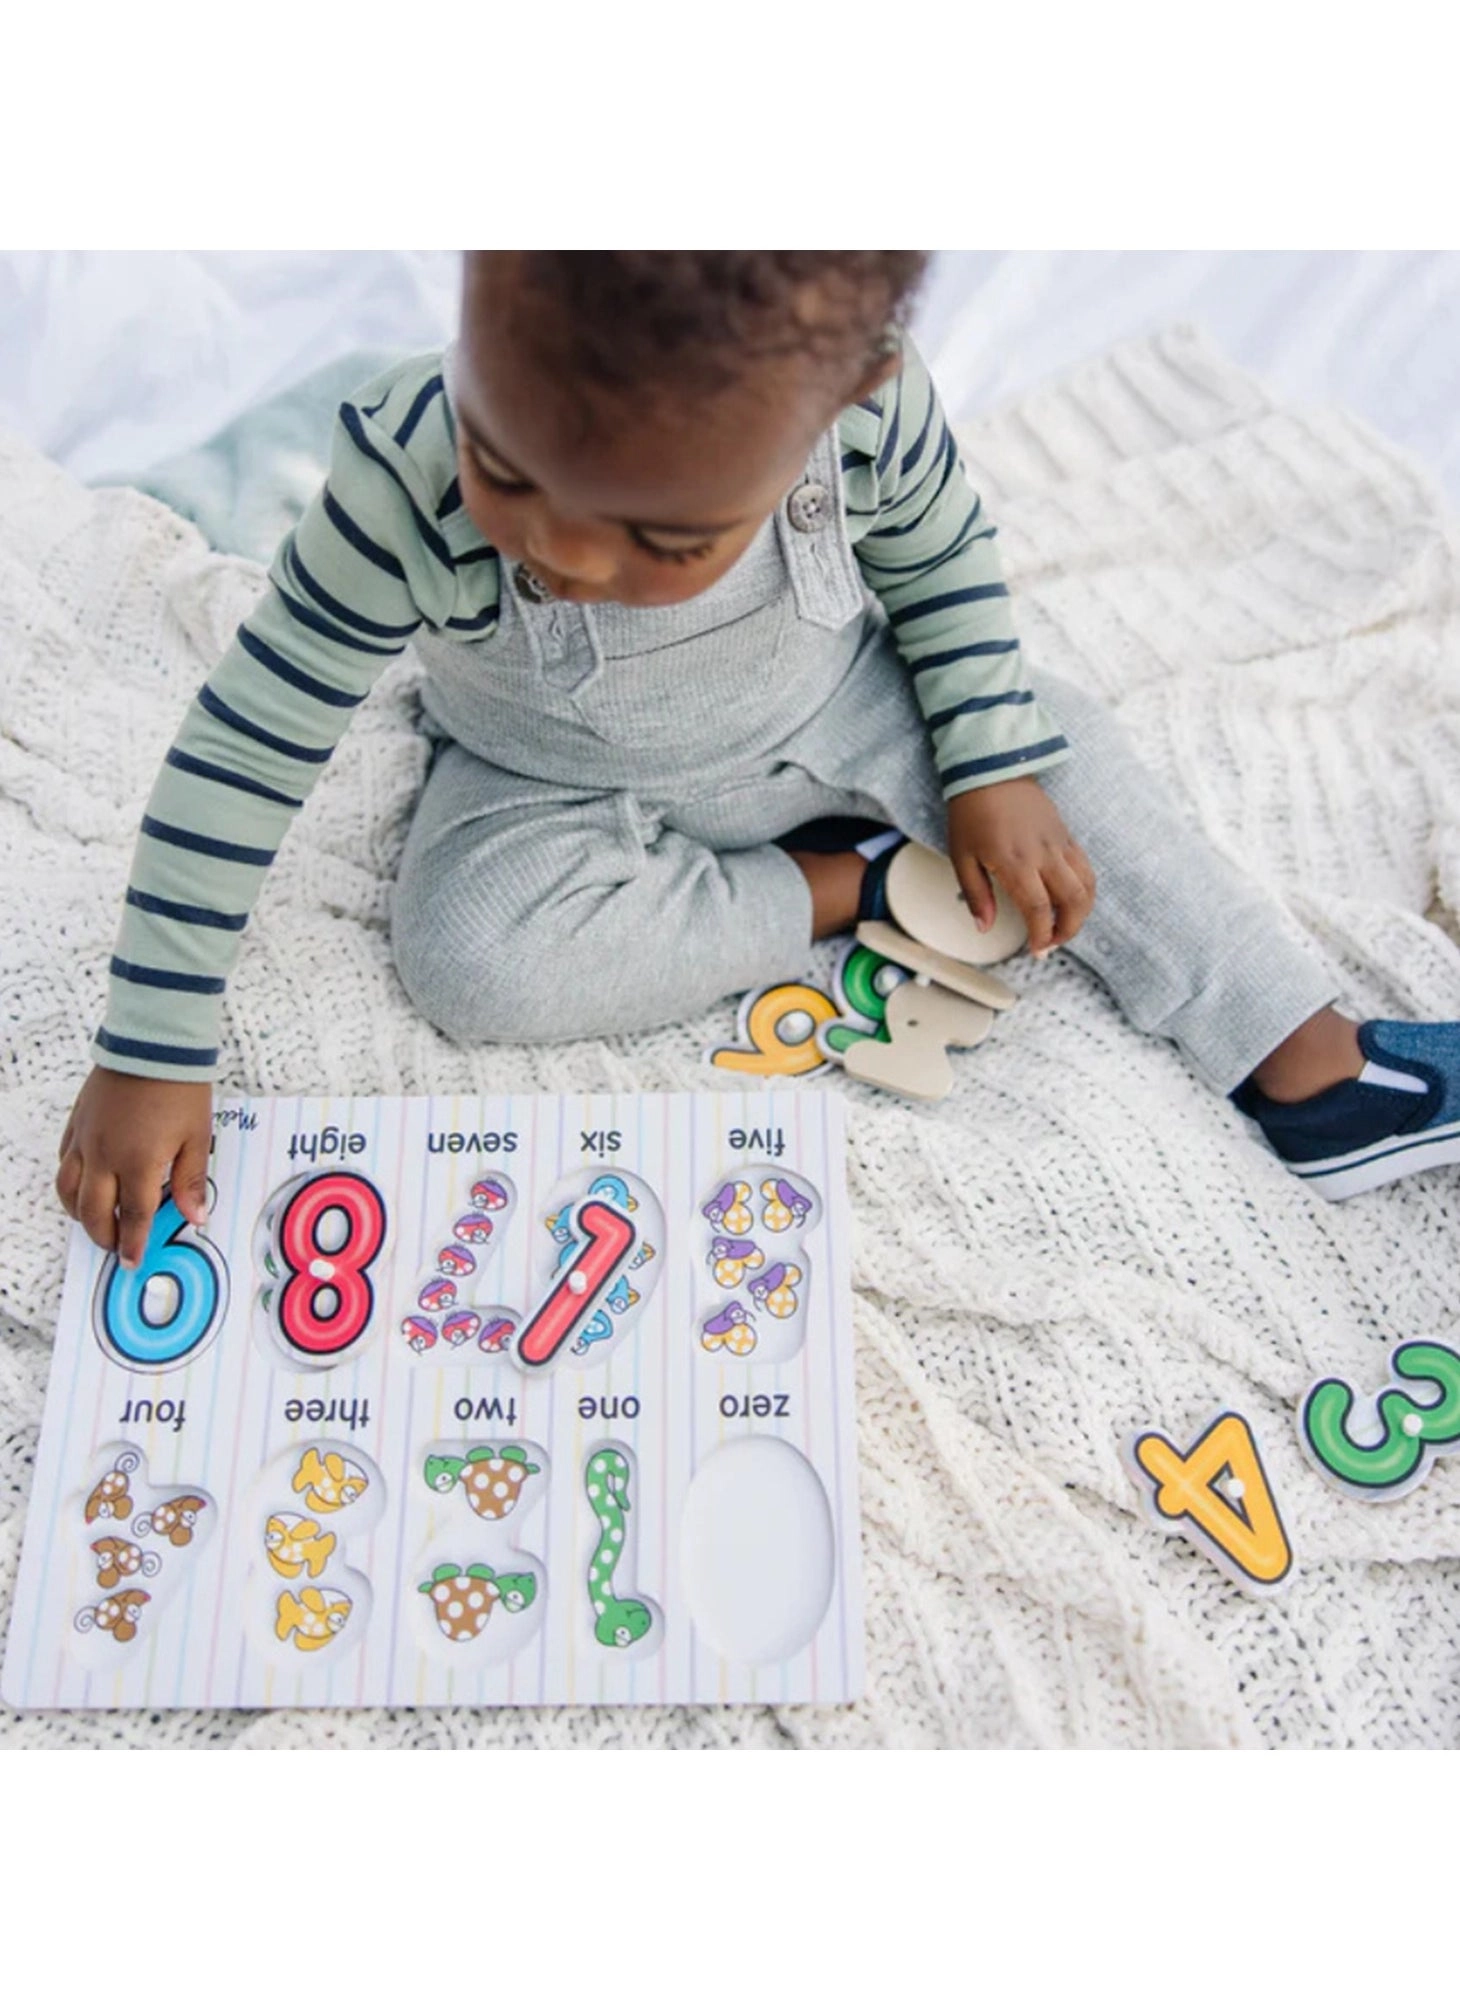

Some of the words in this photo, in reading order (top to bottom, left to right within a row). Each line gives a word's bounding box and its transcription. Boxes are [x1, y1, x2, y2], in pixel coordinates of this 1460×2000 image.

[287, 1126, 367, 1162] eight
[427, 1131, 518, 1153] seven
[579, 1130, 622, 1157] six
[728, 1128, 785, 1157] five
[280, 1172, 387, 1354] 8
[517, 1200, 636, 1367] 1
[119, 1398, 187, 1432] four
[284, 1398, 370, 1430] three
[454, 1397, 517, 1426] two
[578, 1396, 640, 1420] one
[719, 1394, 790, 1418] zero
[1303, 1340, 1460, 1488] 3
[1134, 1411, 1292, 1584] 4
